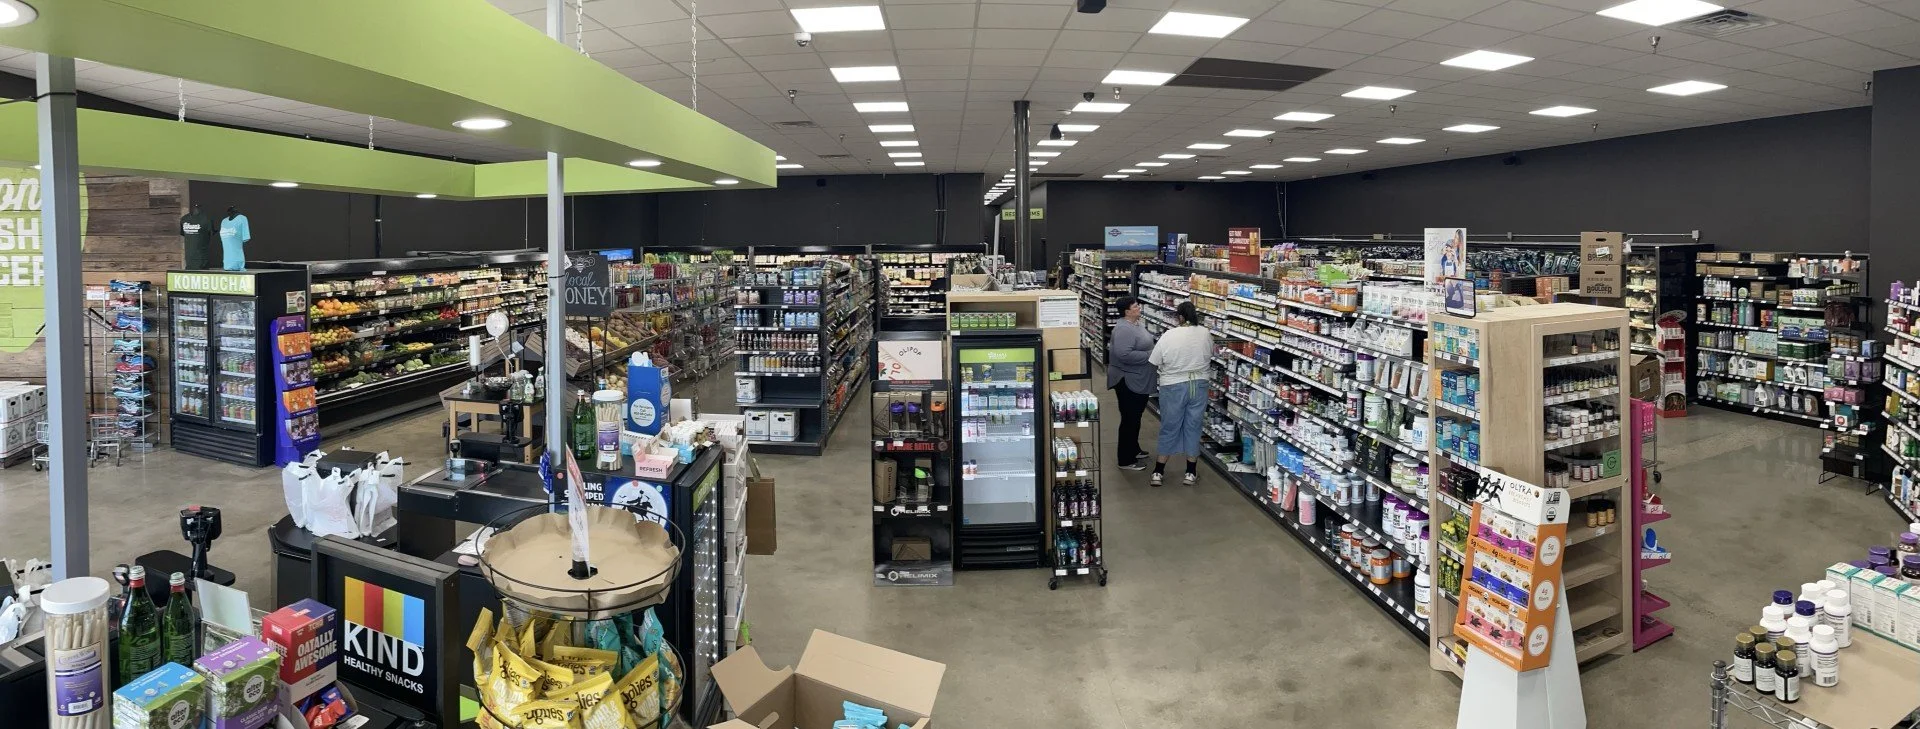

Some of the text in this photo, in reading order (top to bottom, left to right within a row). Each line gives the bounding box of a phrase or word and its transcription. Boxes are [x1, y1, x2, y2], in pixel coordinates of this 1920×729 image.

[174, 275, 248, 291] KOMBUCHA
[565, 287, 609, 305] ONEY
[898, 346, 922, 357] OLIPOP
[1510, 482, 1532, 495] OLYRA
[297, 629, 334, 657] OATALLY
[344, 620, 424, 676] KIND
[294, 640, 338, 673] AWESOME
[344, 655, 424, 694] HEALTHY SNACKS
[246, 681, 263, 694] alter
[248, 687, 261, 699] eco
[170, 707, 188, 721] alter
[172, 714, 186, 727] eco
